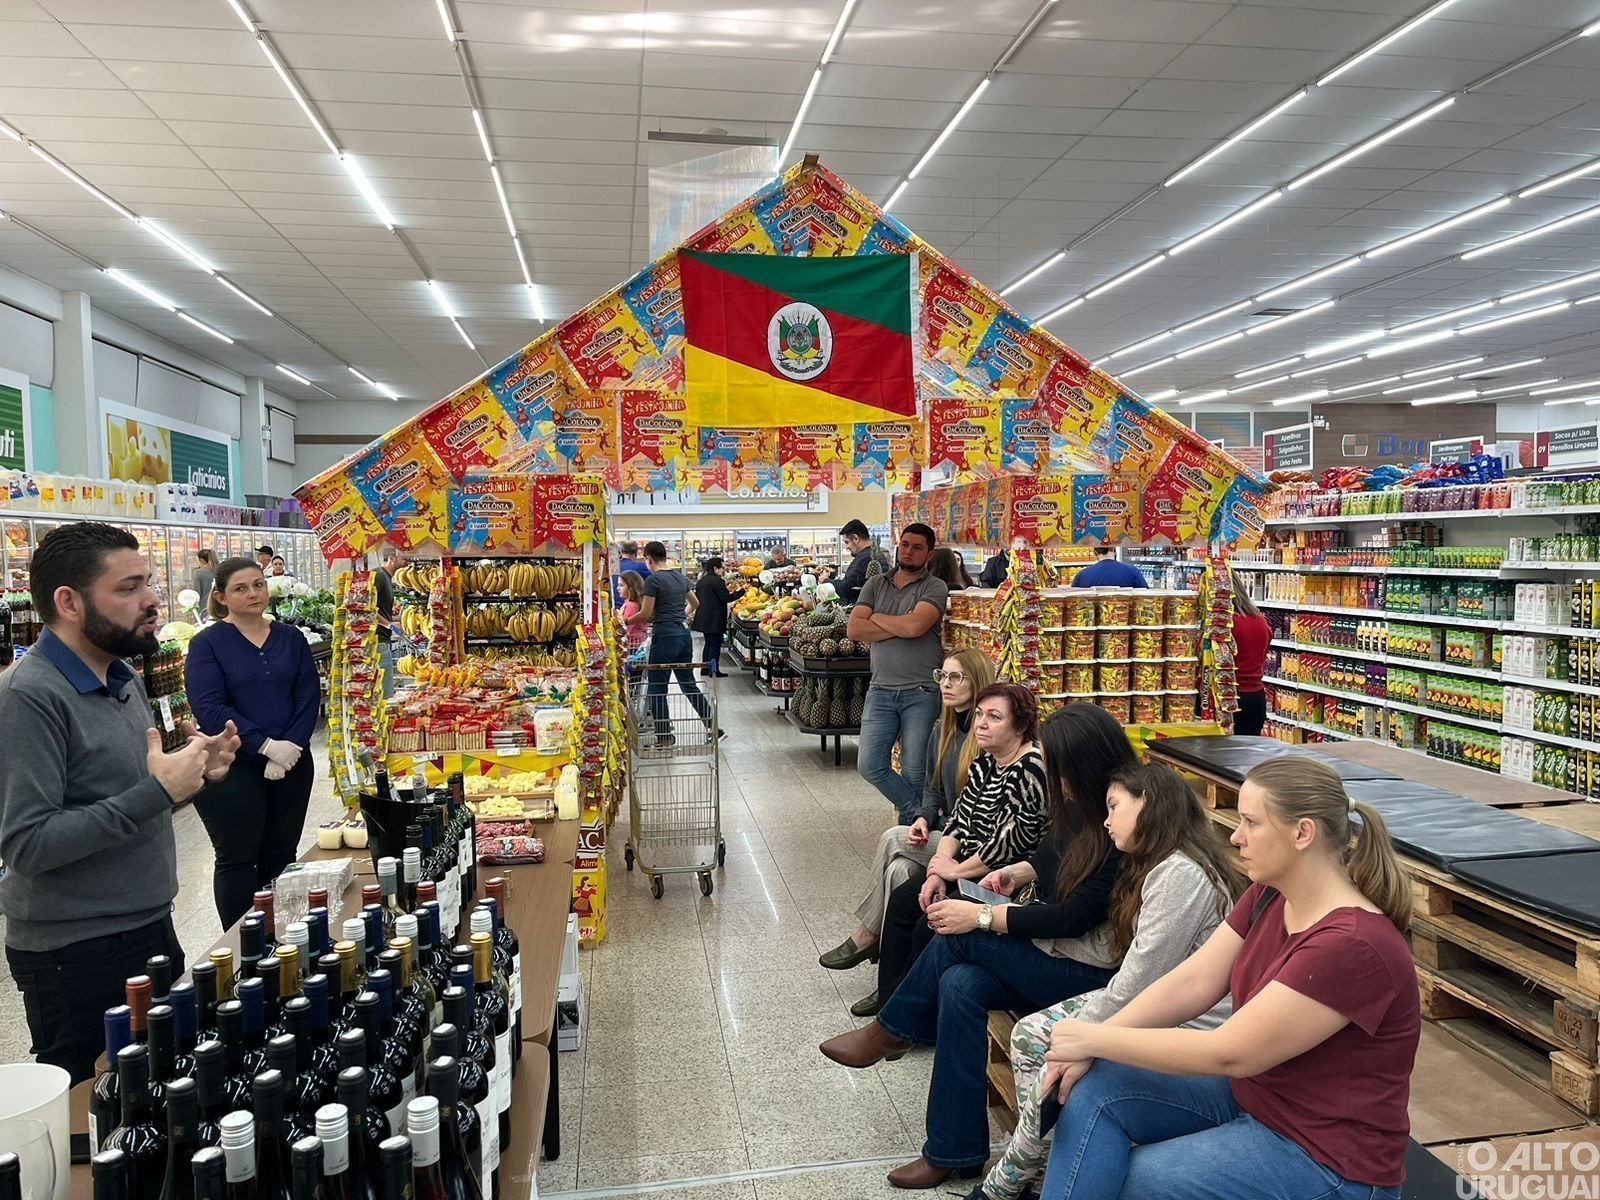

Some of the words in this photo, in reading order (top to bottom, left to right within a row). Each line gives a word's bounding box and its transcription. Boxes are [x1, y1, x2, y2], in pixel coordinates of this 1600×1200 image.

[783, 206, 812, 229] DACOLÔN
[707, 239, 726, 252] STA
[652, 292, 682, 312] DACOLÔN
[505, 369, 525, 388] FESTA
[1064, 371, 1081, 384] FEST
[636, 402, 657, 411] FESTA
[438, 412, 457, 433] FESTA
[563, 418, 598, 426] ACOLÔNIA
[1018, 425, 1047, 433] DACOLÔN
[1579, 429, 1591, 437] Lixo
[1537, 445, 1546, 453] 09
[366, 461, 387, 480] FESTA
[188, 465, 226, 491] Laticínios
[464, 482, 487, 494] FESTA
[549, 484, 571, 495] FESTA
[1016, 487, 1036, 496] FESTA
[1086, 486, 1104, 495] FESTA
[305, 500, 322, 522] STA
